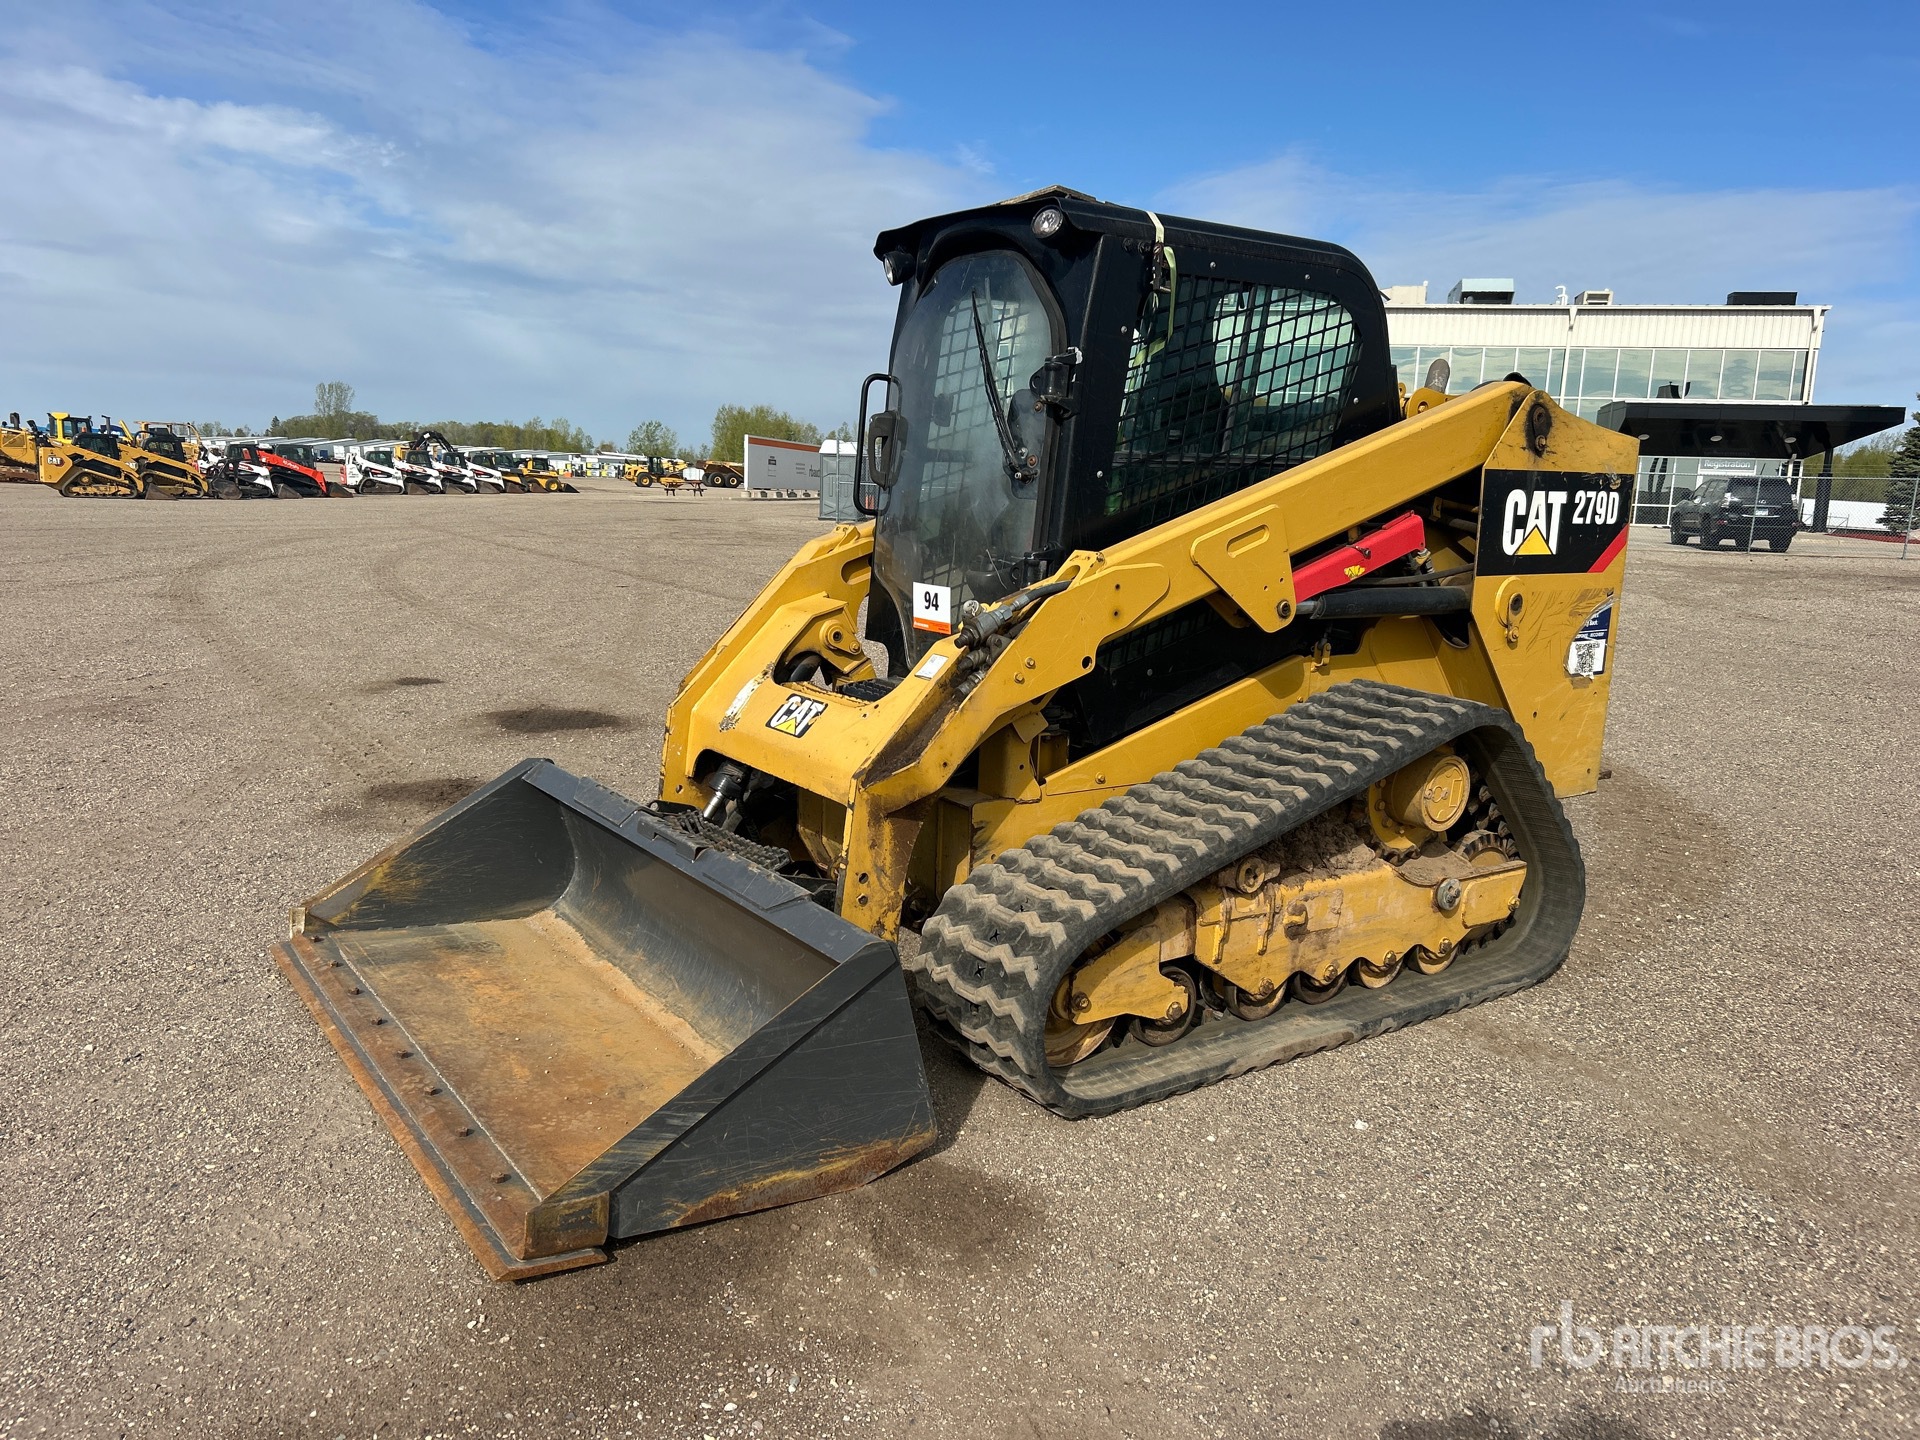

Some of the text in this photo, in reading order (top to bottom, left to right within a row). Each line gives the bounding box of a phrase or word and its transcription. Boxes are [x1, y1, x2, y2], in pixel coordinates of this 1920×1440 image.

[47, 456, 61, 465] CAT
[1704, 459, 1751, 469] Registration
[1502, 488, 1619, 556] CAT 279D
[924, 591, 939, 611] 94
[770, 695, 825, 736] CAT
